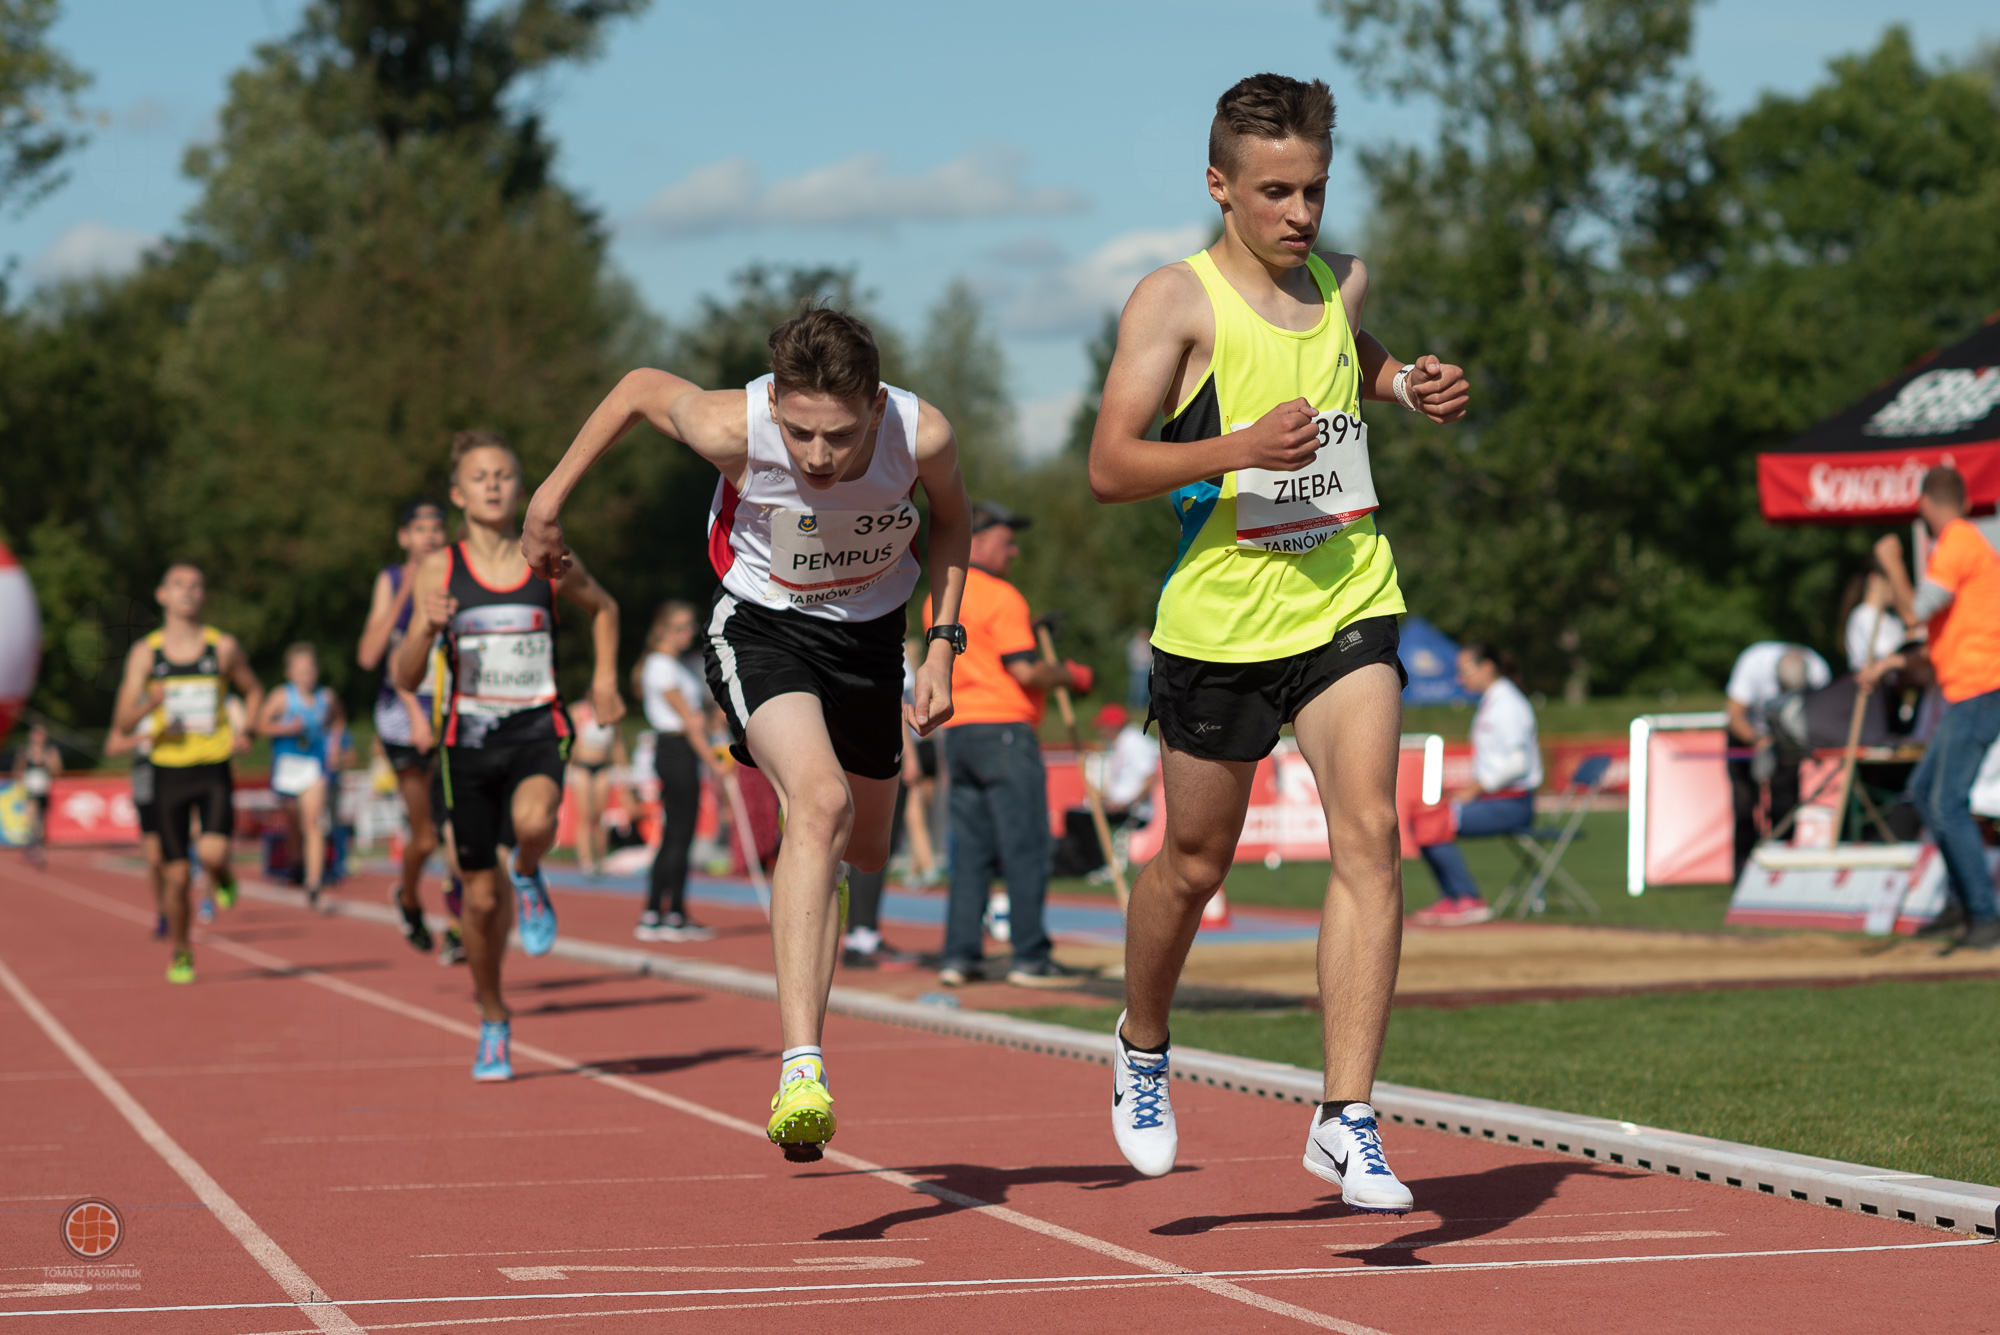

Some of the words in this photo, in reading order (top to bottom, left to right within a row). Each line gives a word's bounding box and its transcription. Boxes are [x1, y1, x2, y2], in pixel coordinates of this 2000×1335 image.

[1274, 471, 1343, 504] ZIĘBA
[854, 506, 913, 535] 395
[1264, 531, 1328, 552] TARNÓW
[793, 543, 893, 571] PEMPUŚ
[789, 589, 851, 604] TARNÓW
[512, 639, 546, 657] 457
